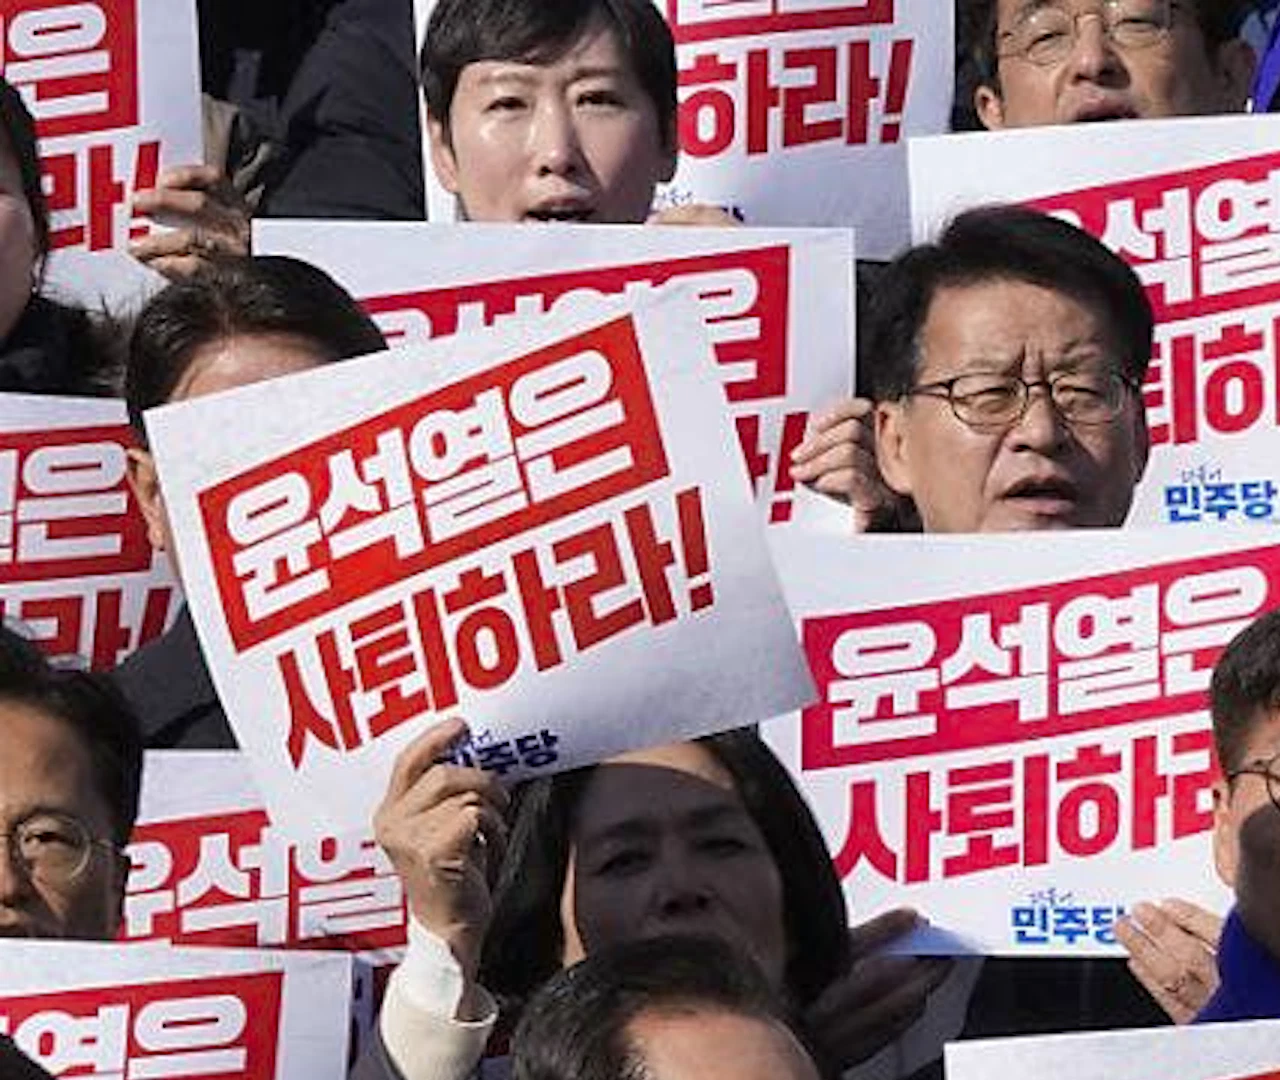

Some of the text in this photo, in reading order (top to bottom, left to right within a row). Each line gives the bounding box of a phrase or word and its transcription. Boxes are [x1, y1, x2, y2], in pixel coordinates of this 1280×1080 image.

[677, 39, 914, 158] 하라!
[226, 350, 634, 622] 윤석열은
[1165, 480, 1278, 522] 민주당
[277, 485, 715, 770] 사퇴하라!
[828, 565, 1268, 747] 윤석열은
[833, 729, 1216, 884] 사퇴하
